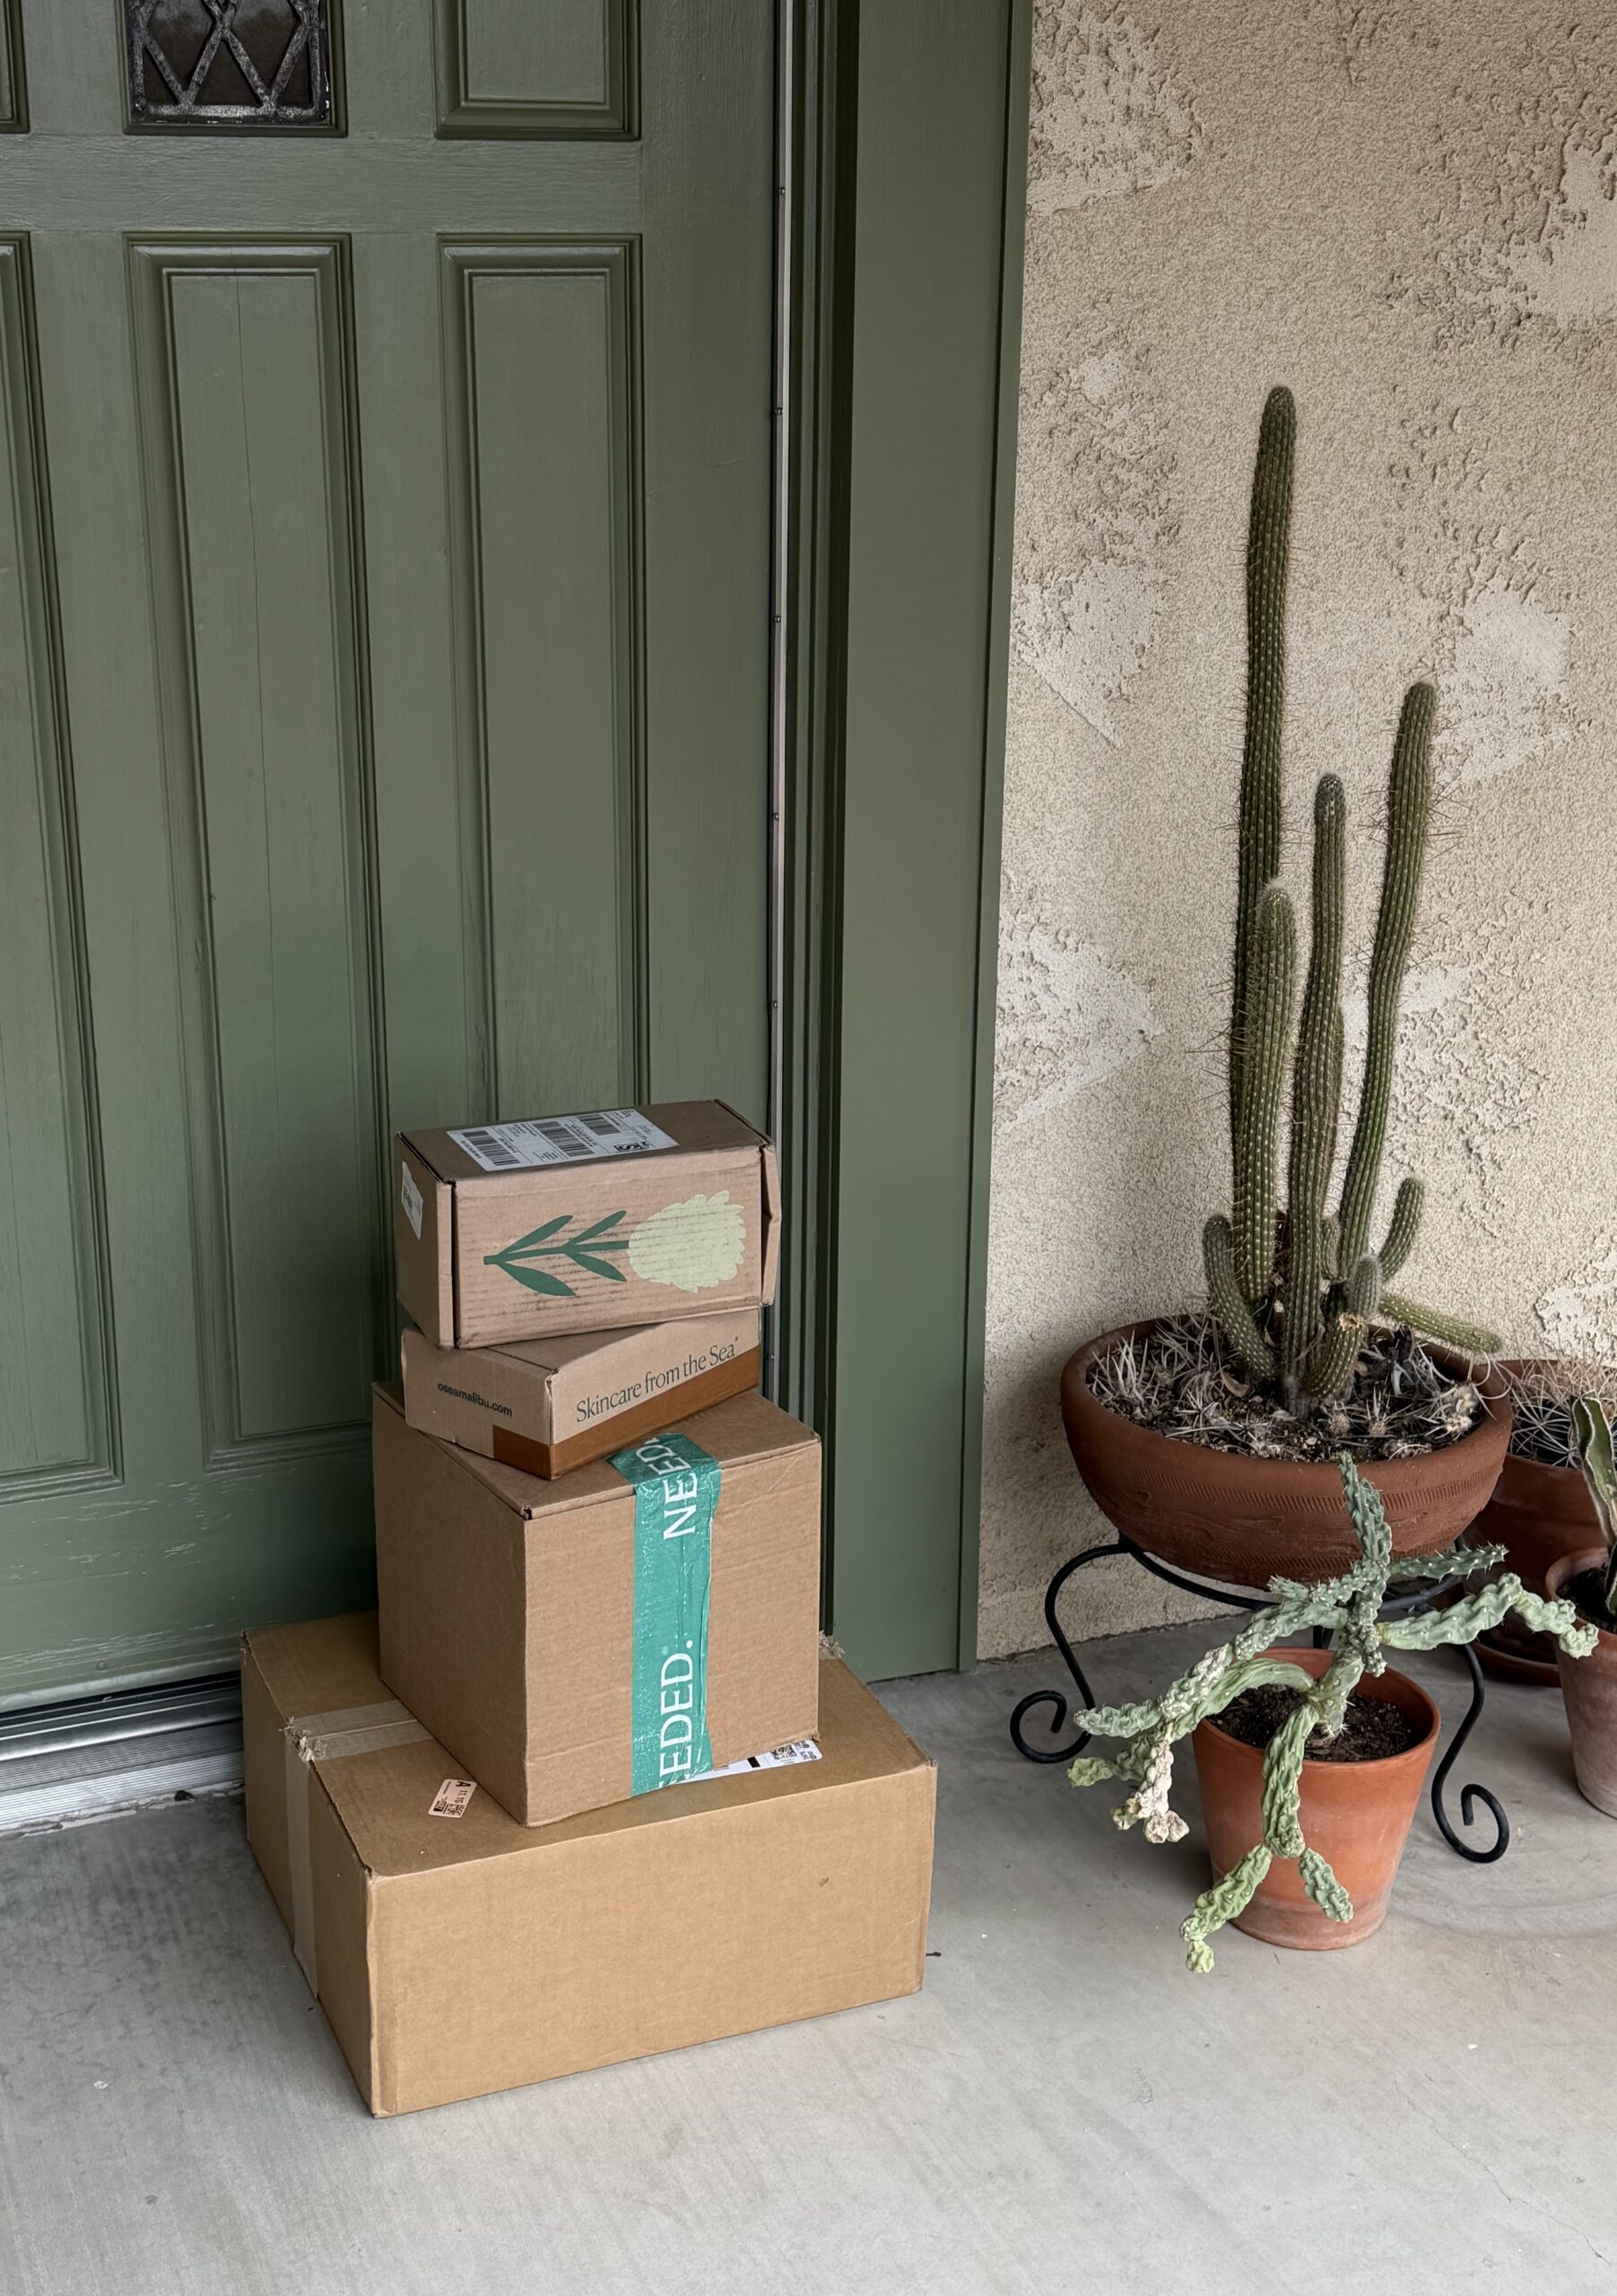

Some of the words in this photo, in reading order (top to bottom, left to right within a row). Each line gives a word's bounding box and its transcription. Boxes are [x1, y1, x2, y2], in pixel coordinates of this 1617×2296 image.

[437, 1382, 513, 1417] oseamalibu.com
[577, 1382, 642, 1422] Skincare
[645, 1366, 680, 1395] from
[683, 1354, 708, 1378] the
[658, 1639, 693, 1788] EDED.
